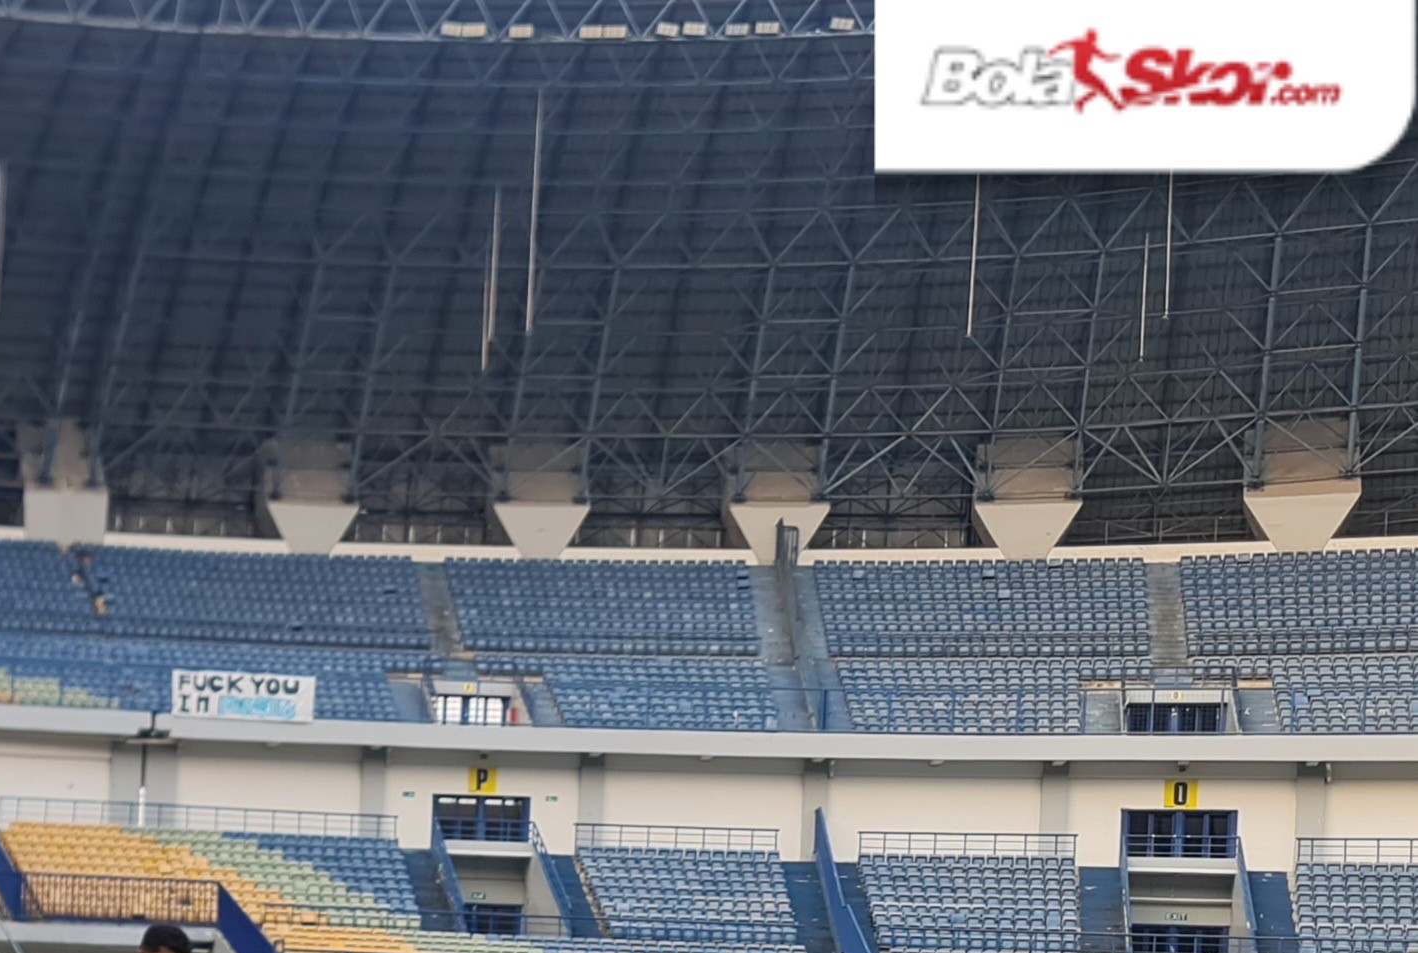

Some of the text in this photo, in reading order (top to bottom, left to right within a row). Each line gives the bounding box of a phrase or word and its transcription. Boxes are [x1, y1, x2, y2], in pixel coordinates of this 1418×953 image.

[179, 674, 300, 695] FUCK YOU
[476, 768, 488, 790] P
